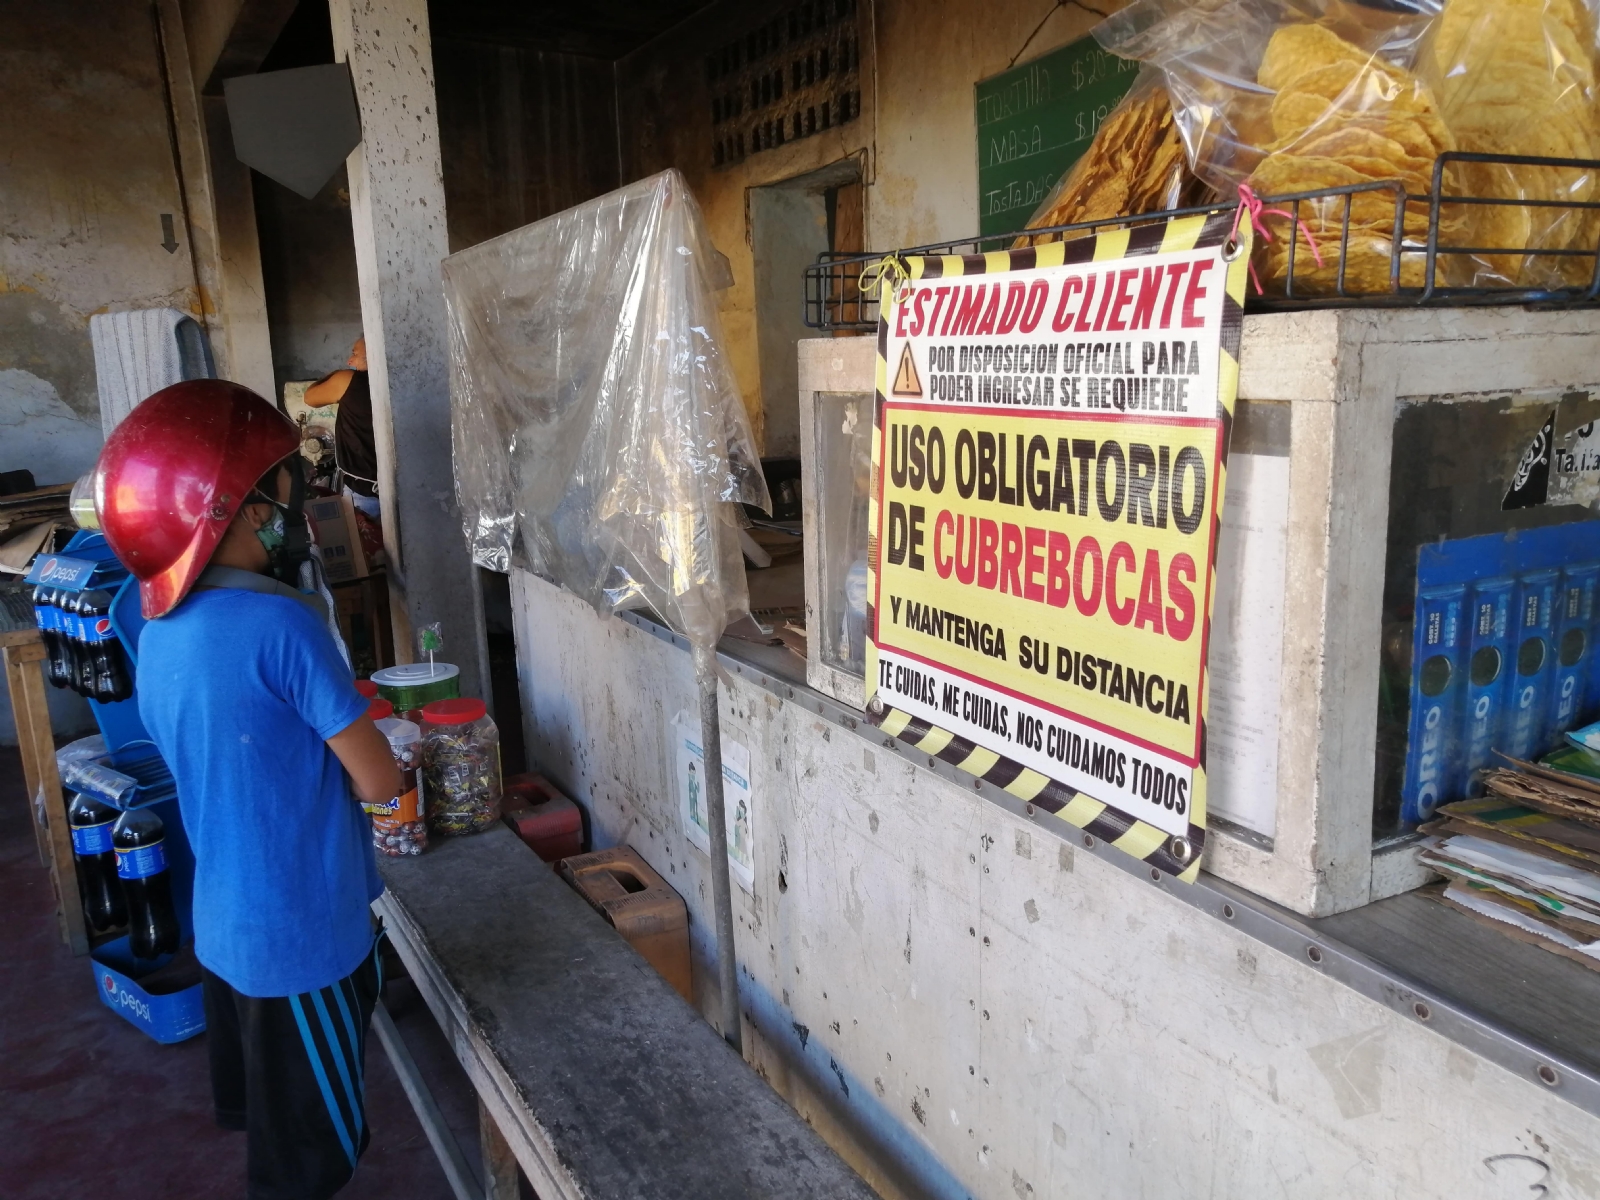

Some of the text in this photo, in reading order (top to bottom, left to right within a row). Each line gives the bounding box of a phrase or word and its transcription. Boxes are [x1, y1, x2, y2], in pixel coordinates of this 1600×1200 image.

[990, 125, 1041, 167] MASA
[895, 258, 1214, 337] ESTIMADO CLIENTE
[928, 341, 1200, 375] POR DISPOSICION OFICIAL PARA
[930, 374, 1190, 413] PODER INGRESAR SE REQUIERE
[890, 423, 1206, 535] USO OBLIGATORIO
[50, 567, 81, 583] pepsi
[887, 502, 1197, 642] DE CUBREBOCAS
[890, 595, 1190, 725] Y MANTENGA SU DISTANCIA
[879, 659, 1188, 816] TE CUIDAS, ME CUIDAS, NOS CUIDAMOS TODOS
[1417, 705, 1440, 821] OREO
[121, 990, 152, 1024] pepsi
